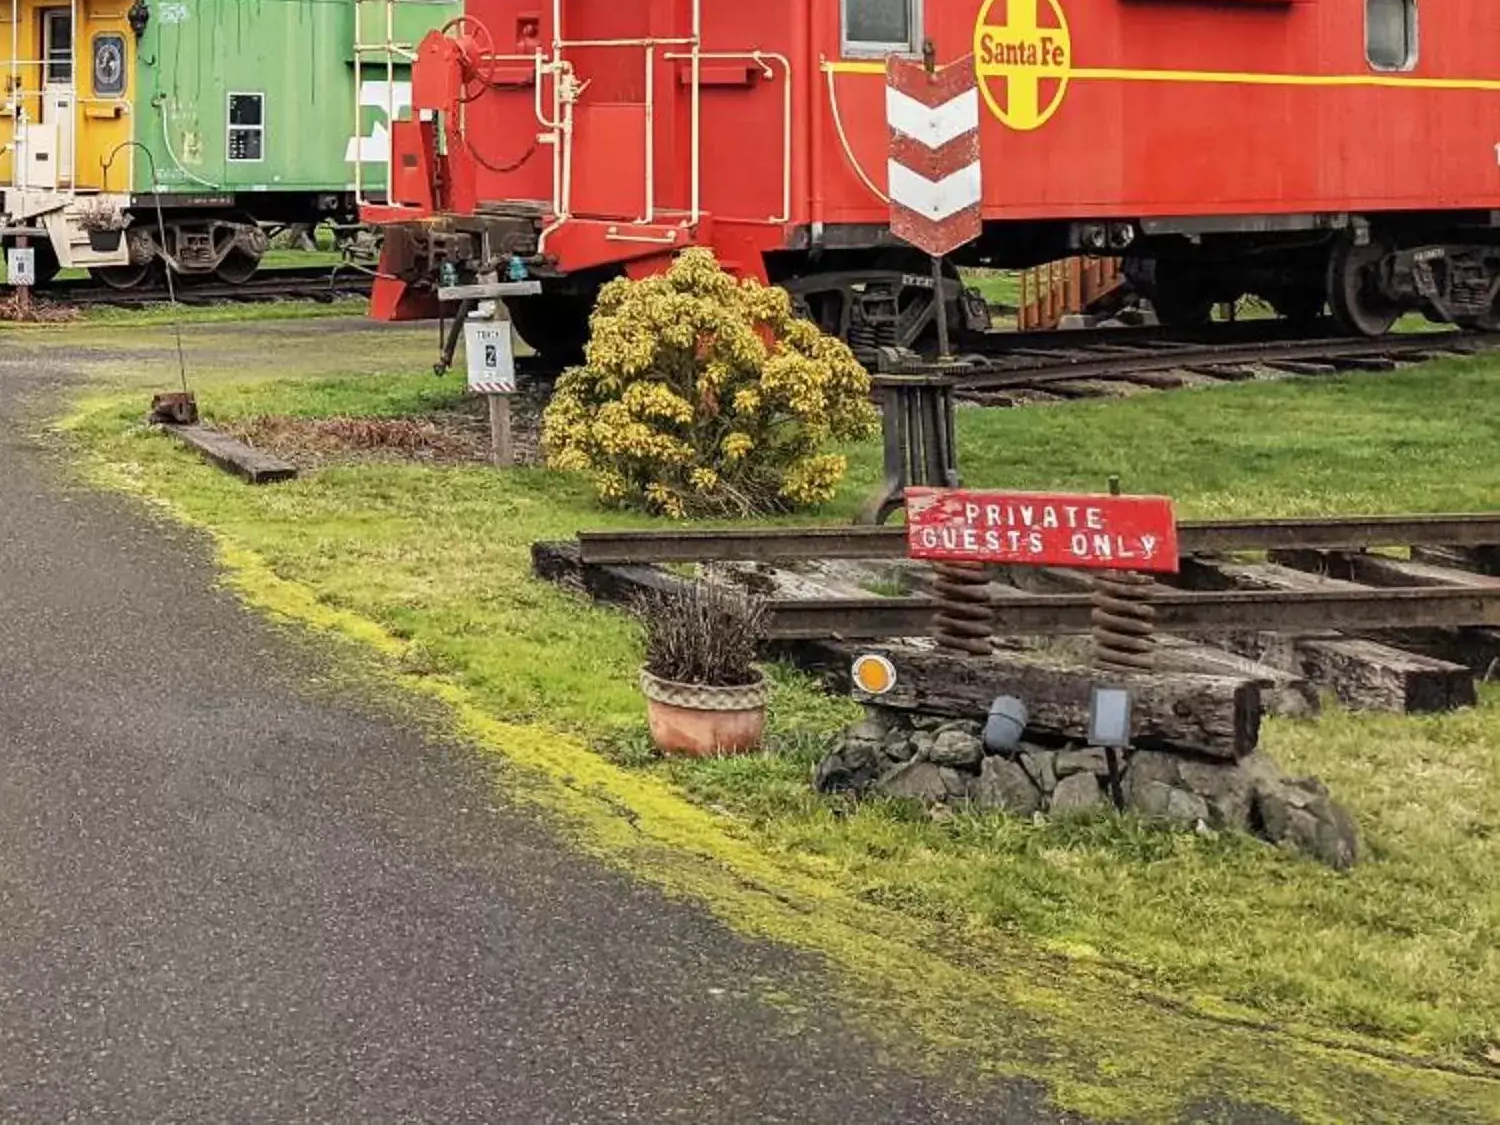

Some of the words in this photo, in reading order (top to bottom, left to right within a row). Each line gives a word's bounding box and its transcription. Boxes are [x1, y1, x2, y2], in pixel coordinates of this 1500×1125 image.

[980, 32, 1037, 66] Santa
[1040, 36, 1065, 67] Fe
[965, 503, 1105, 530] PRIVATE
[922, 528, 1044, 553] GUESTS
[1071, 533, 1157, 558] ONLY
